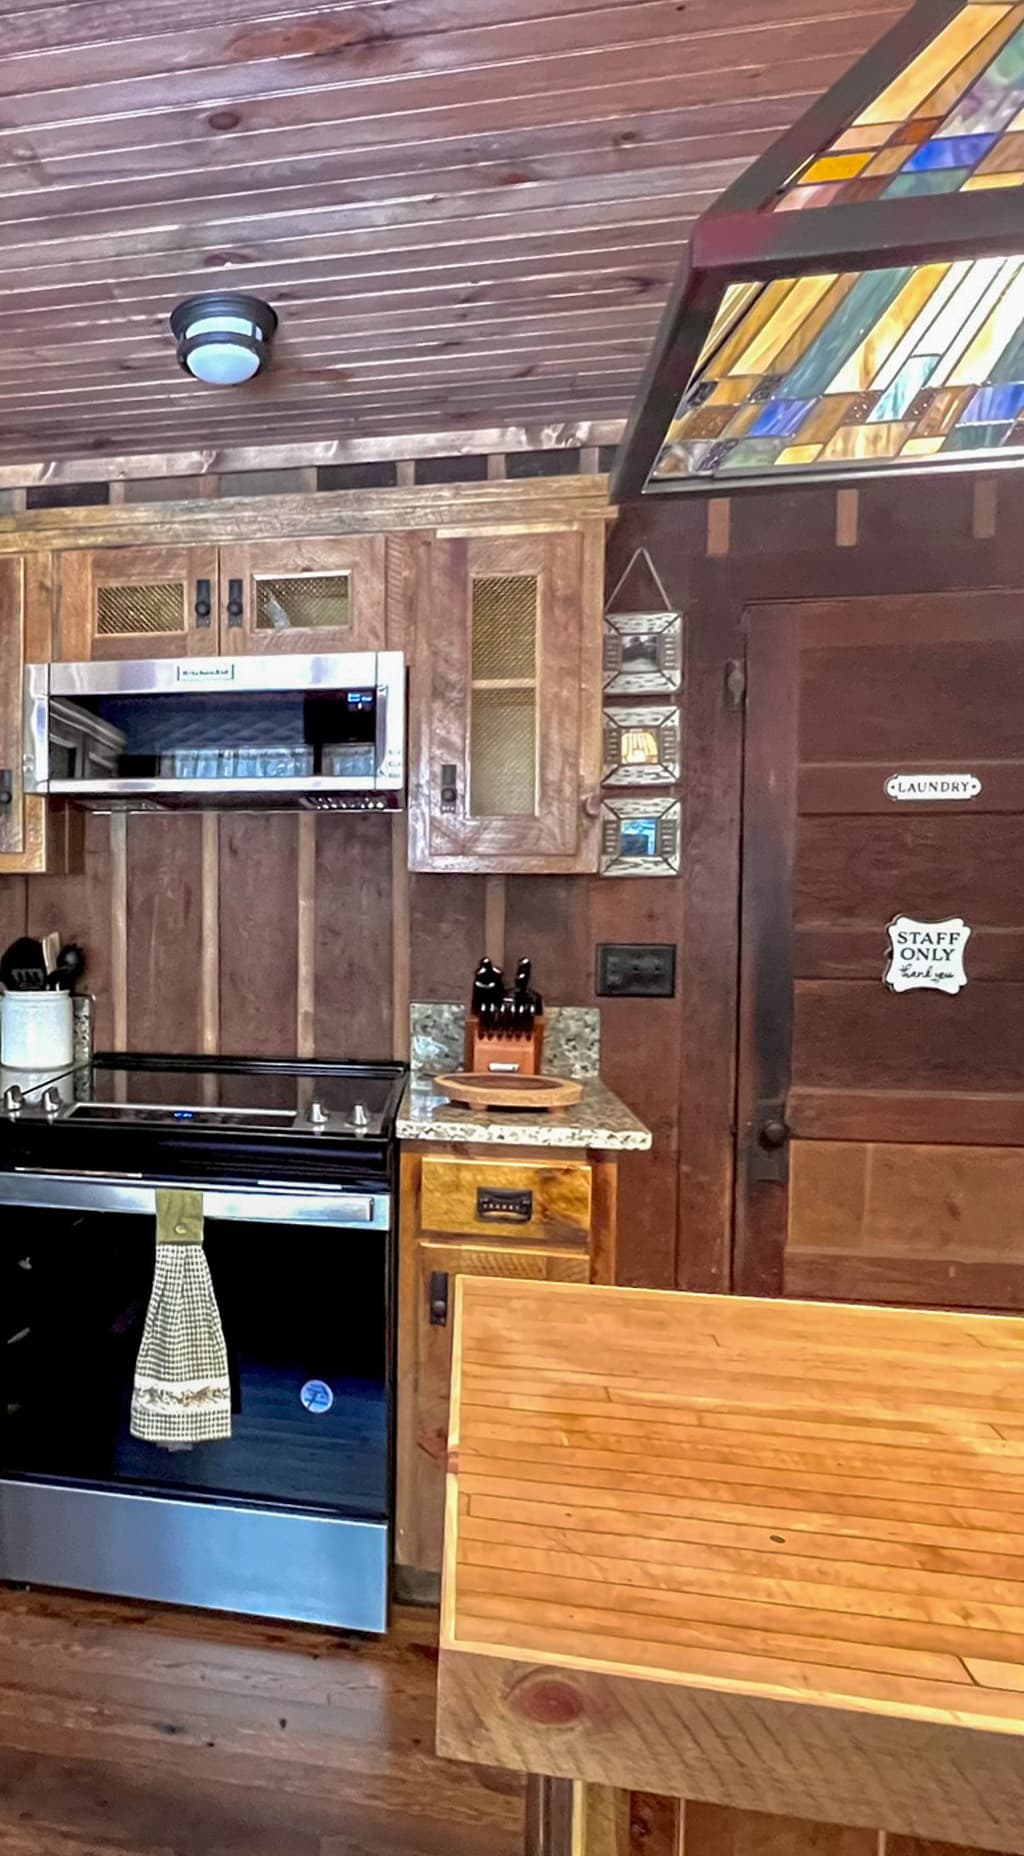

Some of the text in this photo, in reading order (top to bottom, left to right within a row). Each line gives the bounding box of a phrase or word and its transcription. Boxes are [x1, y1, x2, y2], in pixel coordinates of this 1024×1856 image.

[898, 782, 969, 793] LAUNDRY
[897, 931, 961, 945] STAFF
[900, 947, 955, 961] ONLY
